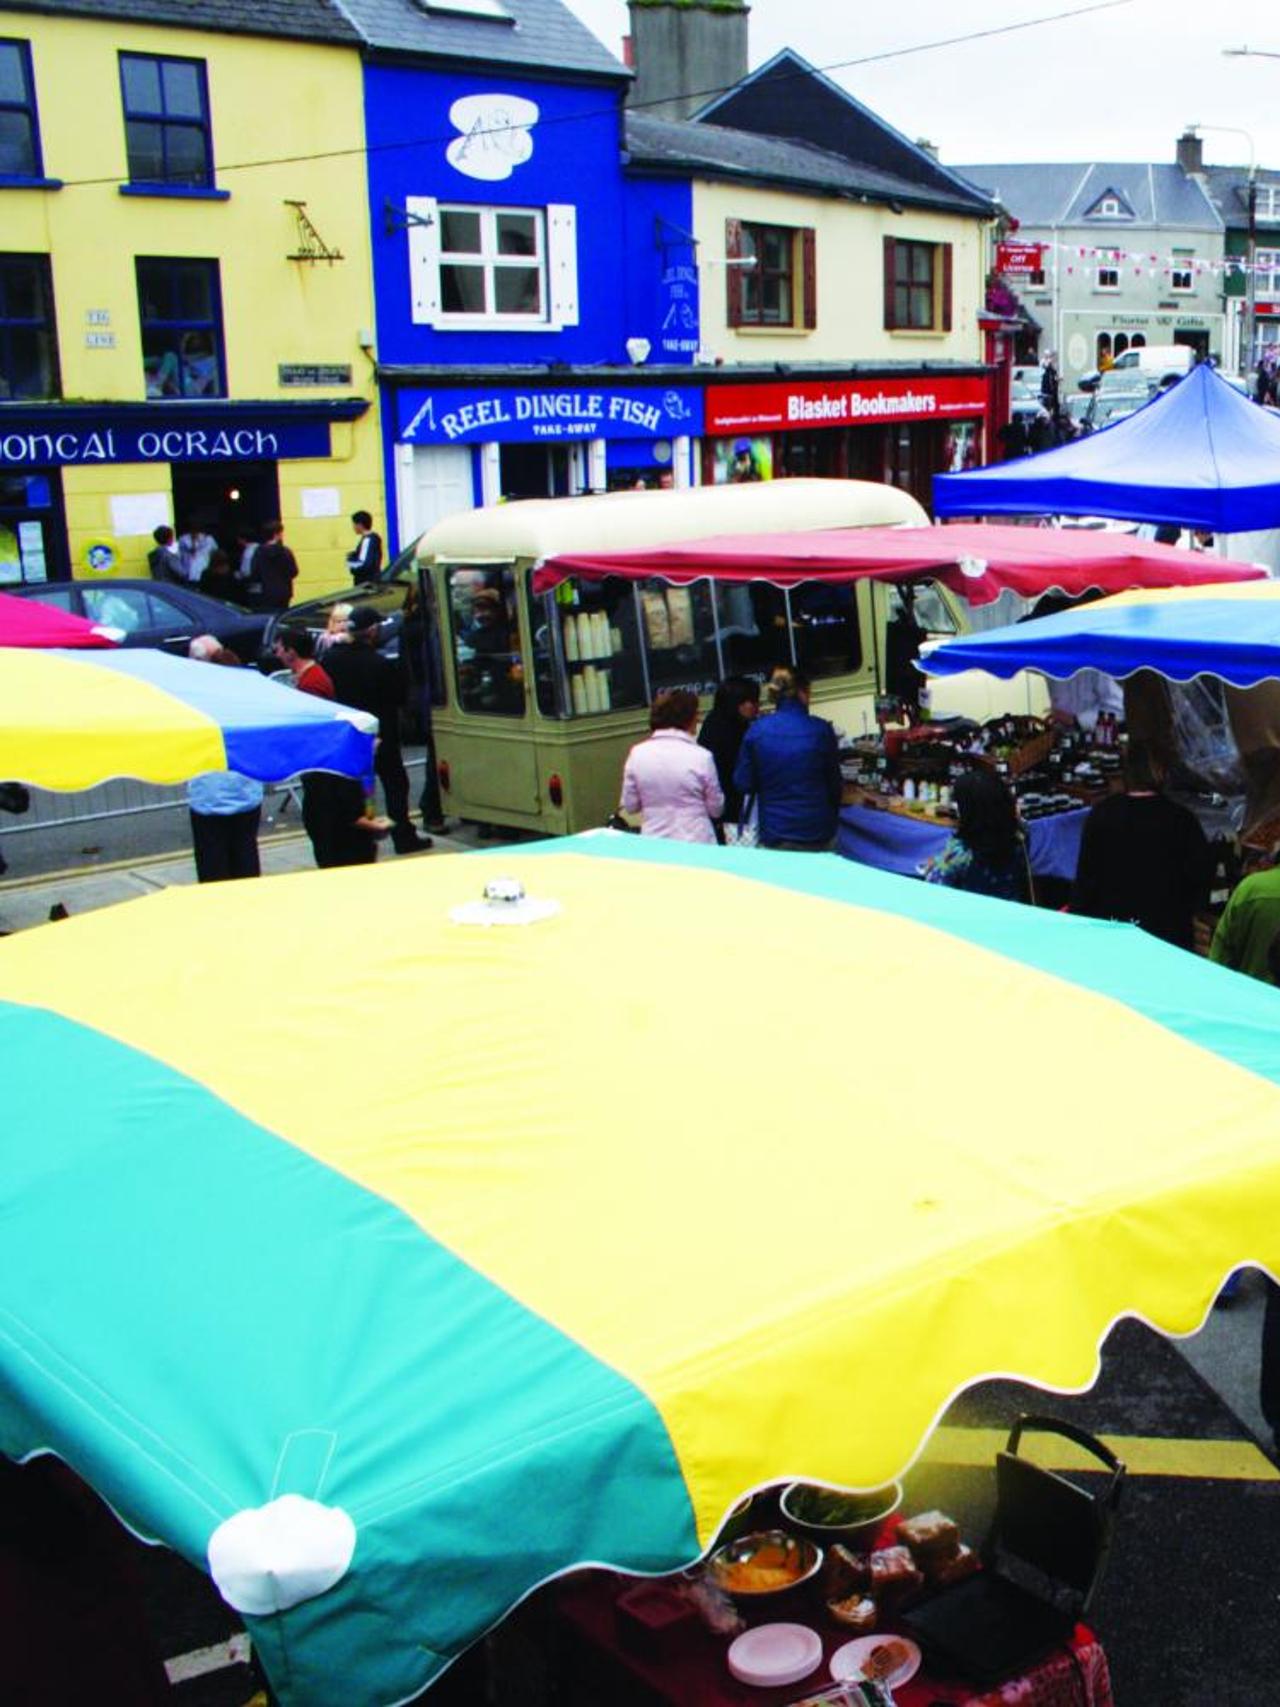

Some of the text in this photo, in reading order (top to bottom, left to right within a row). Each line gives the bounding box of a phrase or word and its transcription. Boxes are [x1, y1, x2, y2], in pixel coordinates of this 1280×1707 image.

[440, 394, 661, 440] REEL DINGLE FISH
[787, 394, 847, 421] Blasket
[850, 390, 936, 417] Bookmakers
[532, 423, 597, 436] TAKE-AWAY
